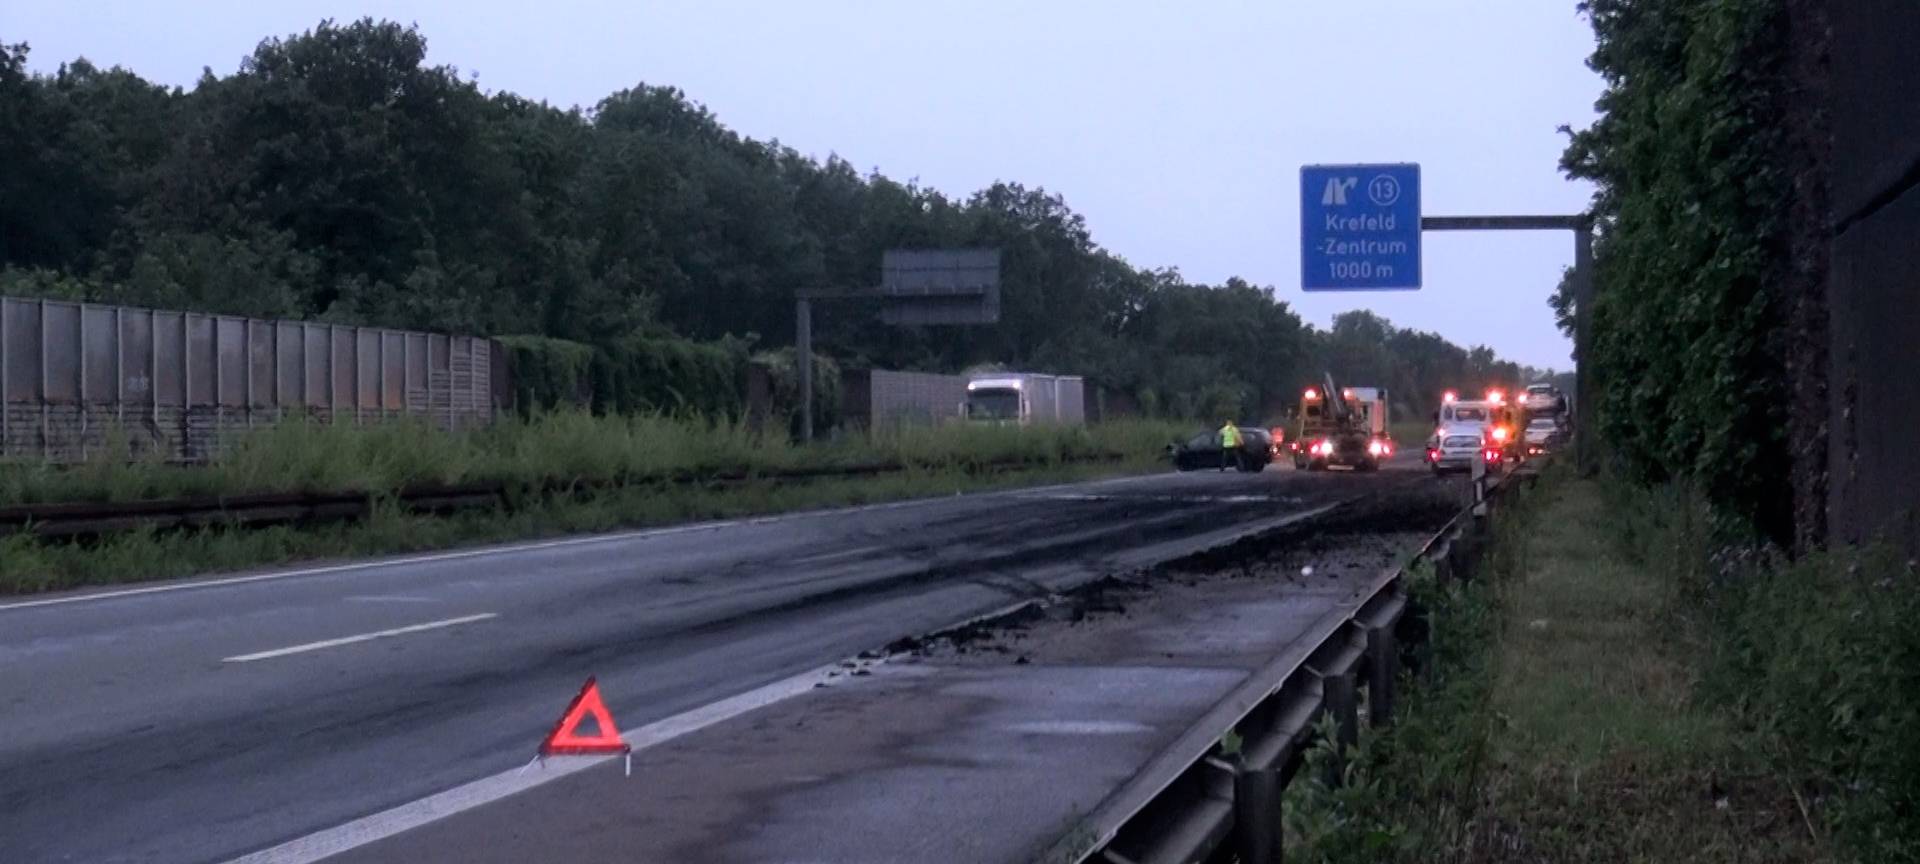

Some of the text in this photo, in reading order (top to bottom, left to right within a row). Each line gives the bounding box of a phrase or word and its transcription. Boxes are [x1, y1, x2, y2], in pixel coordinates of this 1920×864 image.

[1375, 181, 1394, 199] 13
[1325, 213, 1396, 231] Krefeld
[1317, 238, 1407, 255] -Zentrum
[1329, 261, 1393, 279] 1000 m
